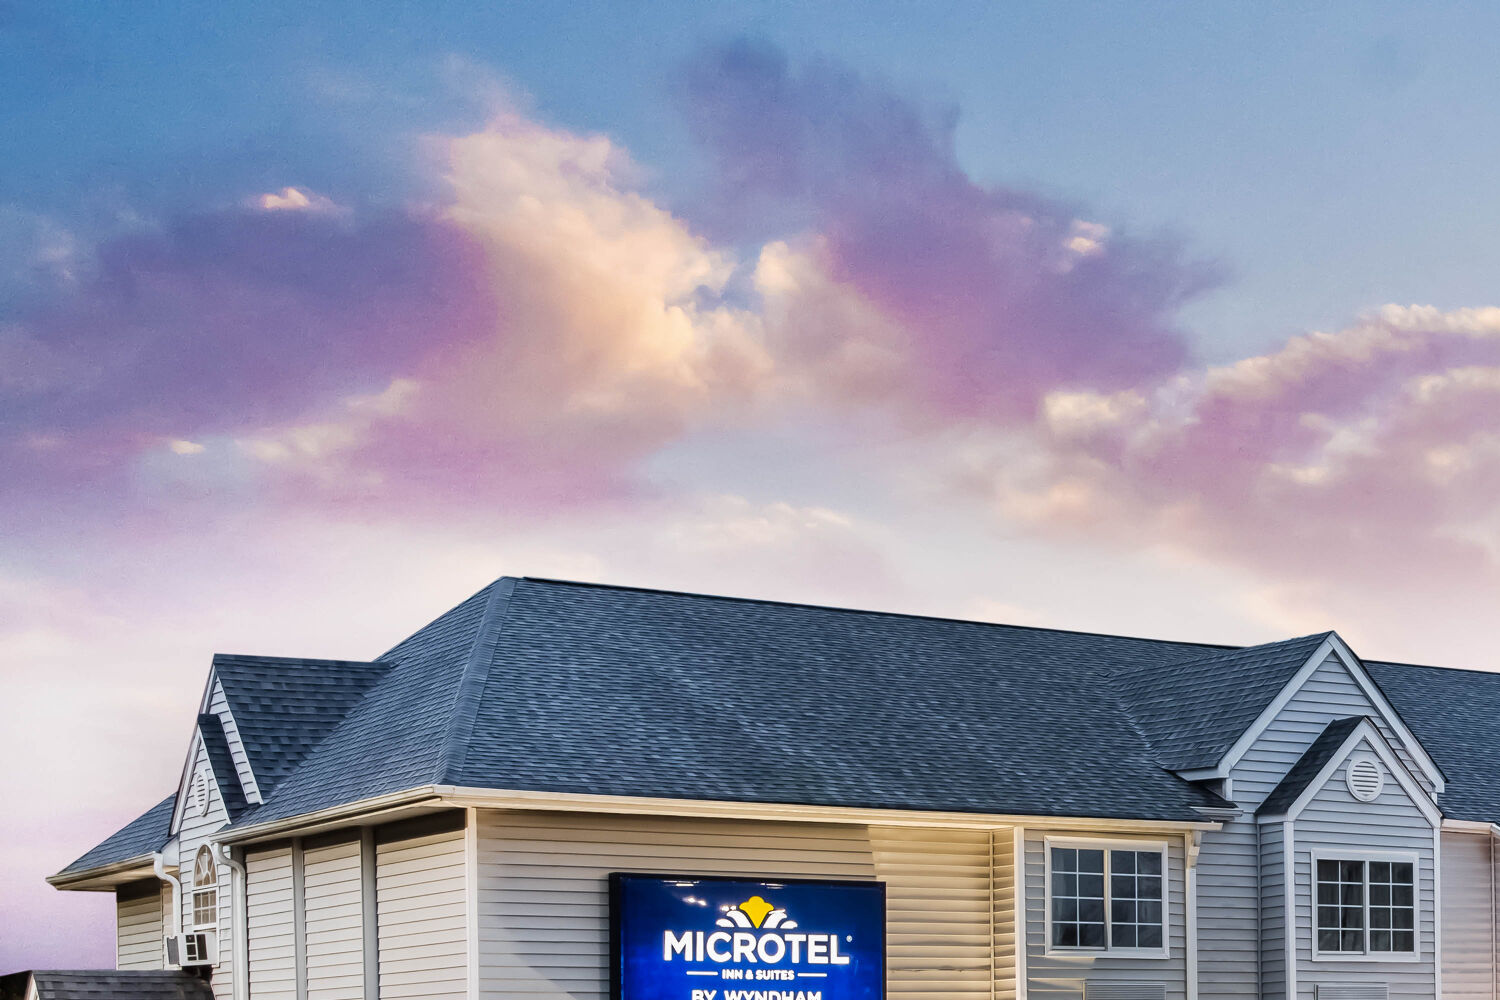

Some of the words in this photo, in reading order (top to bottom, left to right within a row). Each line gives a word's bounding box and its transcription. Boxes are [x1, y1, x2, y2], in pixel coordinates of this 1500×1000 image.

[663, 930, 850, 965] MICROTEL
[721, 969, 743, 980] INN
[745, 969, 754, 980] &
[755, 969, 795, 981] SUITES
